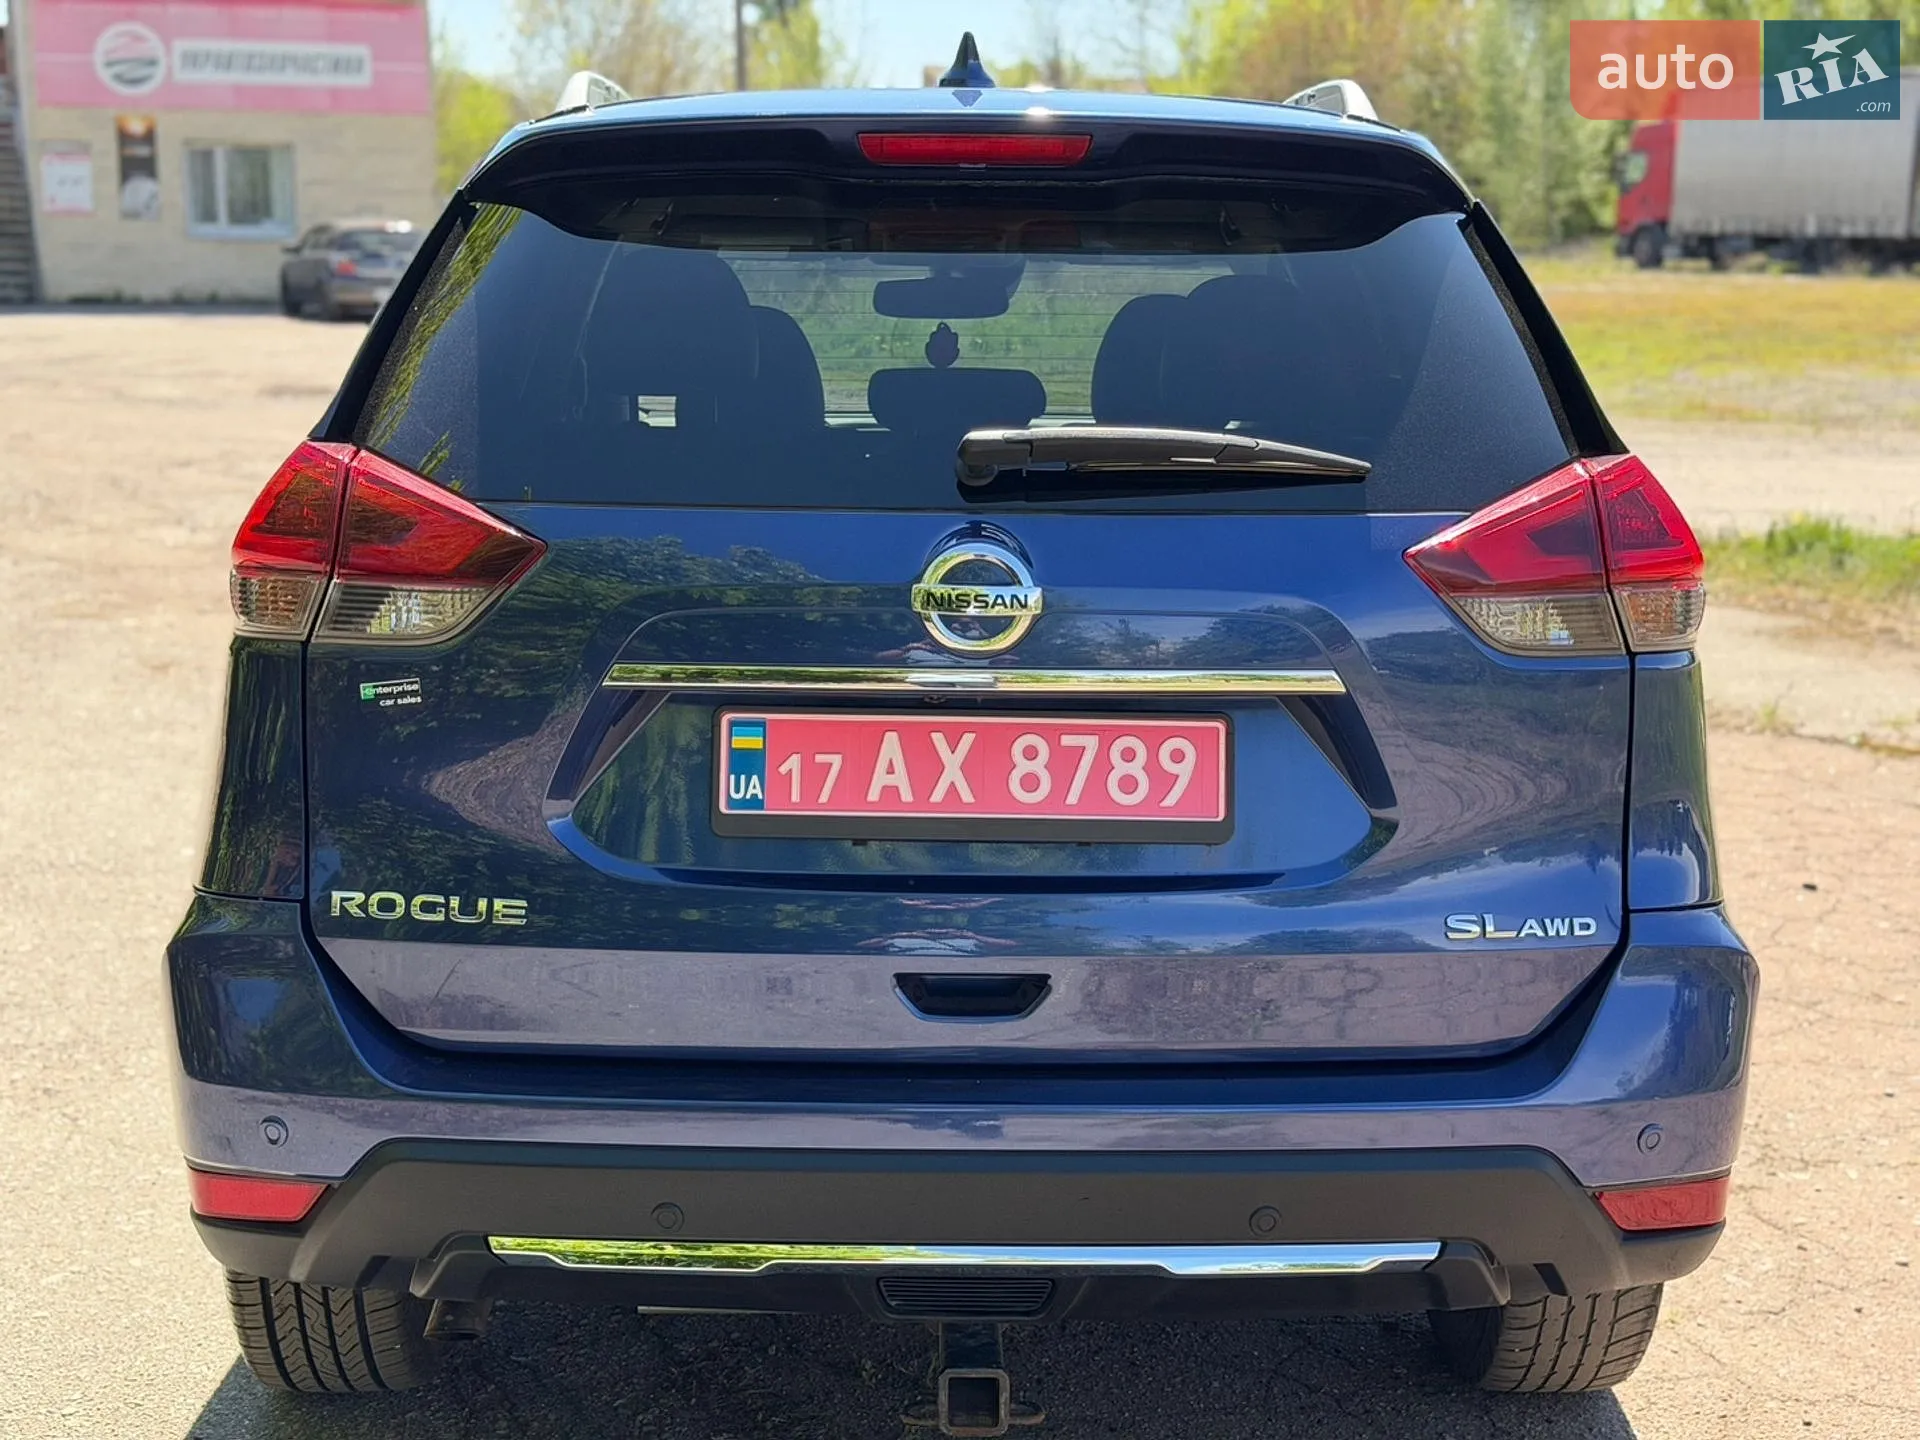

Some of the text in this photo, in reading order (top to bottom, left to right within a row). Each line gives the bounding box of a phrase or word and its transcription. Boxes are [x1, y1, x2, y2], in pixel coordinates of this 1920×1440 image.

[925, 592, 1030, 611] NISSAN
[364, 683, 420, 696] enterprise
[397, 695, 422, 704] sales
[776, 730, 1198, 808] 17 AX 8789
[729, 773, 764, 801] UA
[330, 890, 528, 926] ROGUE
